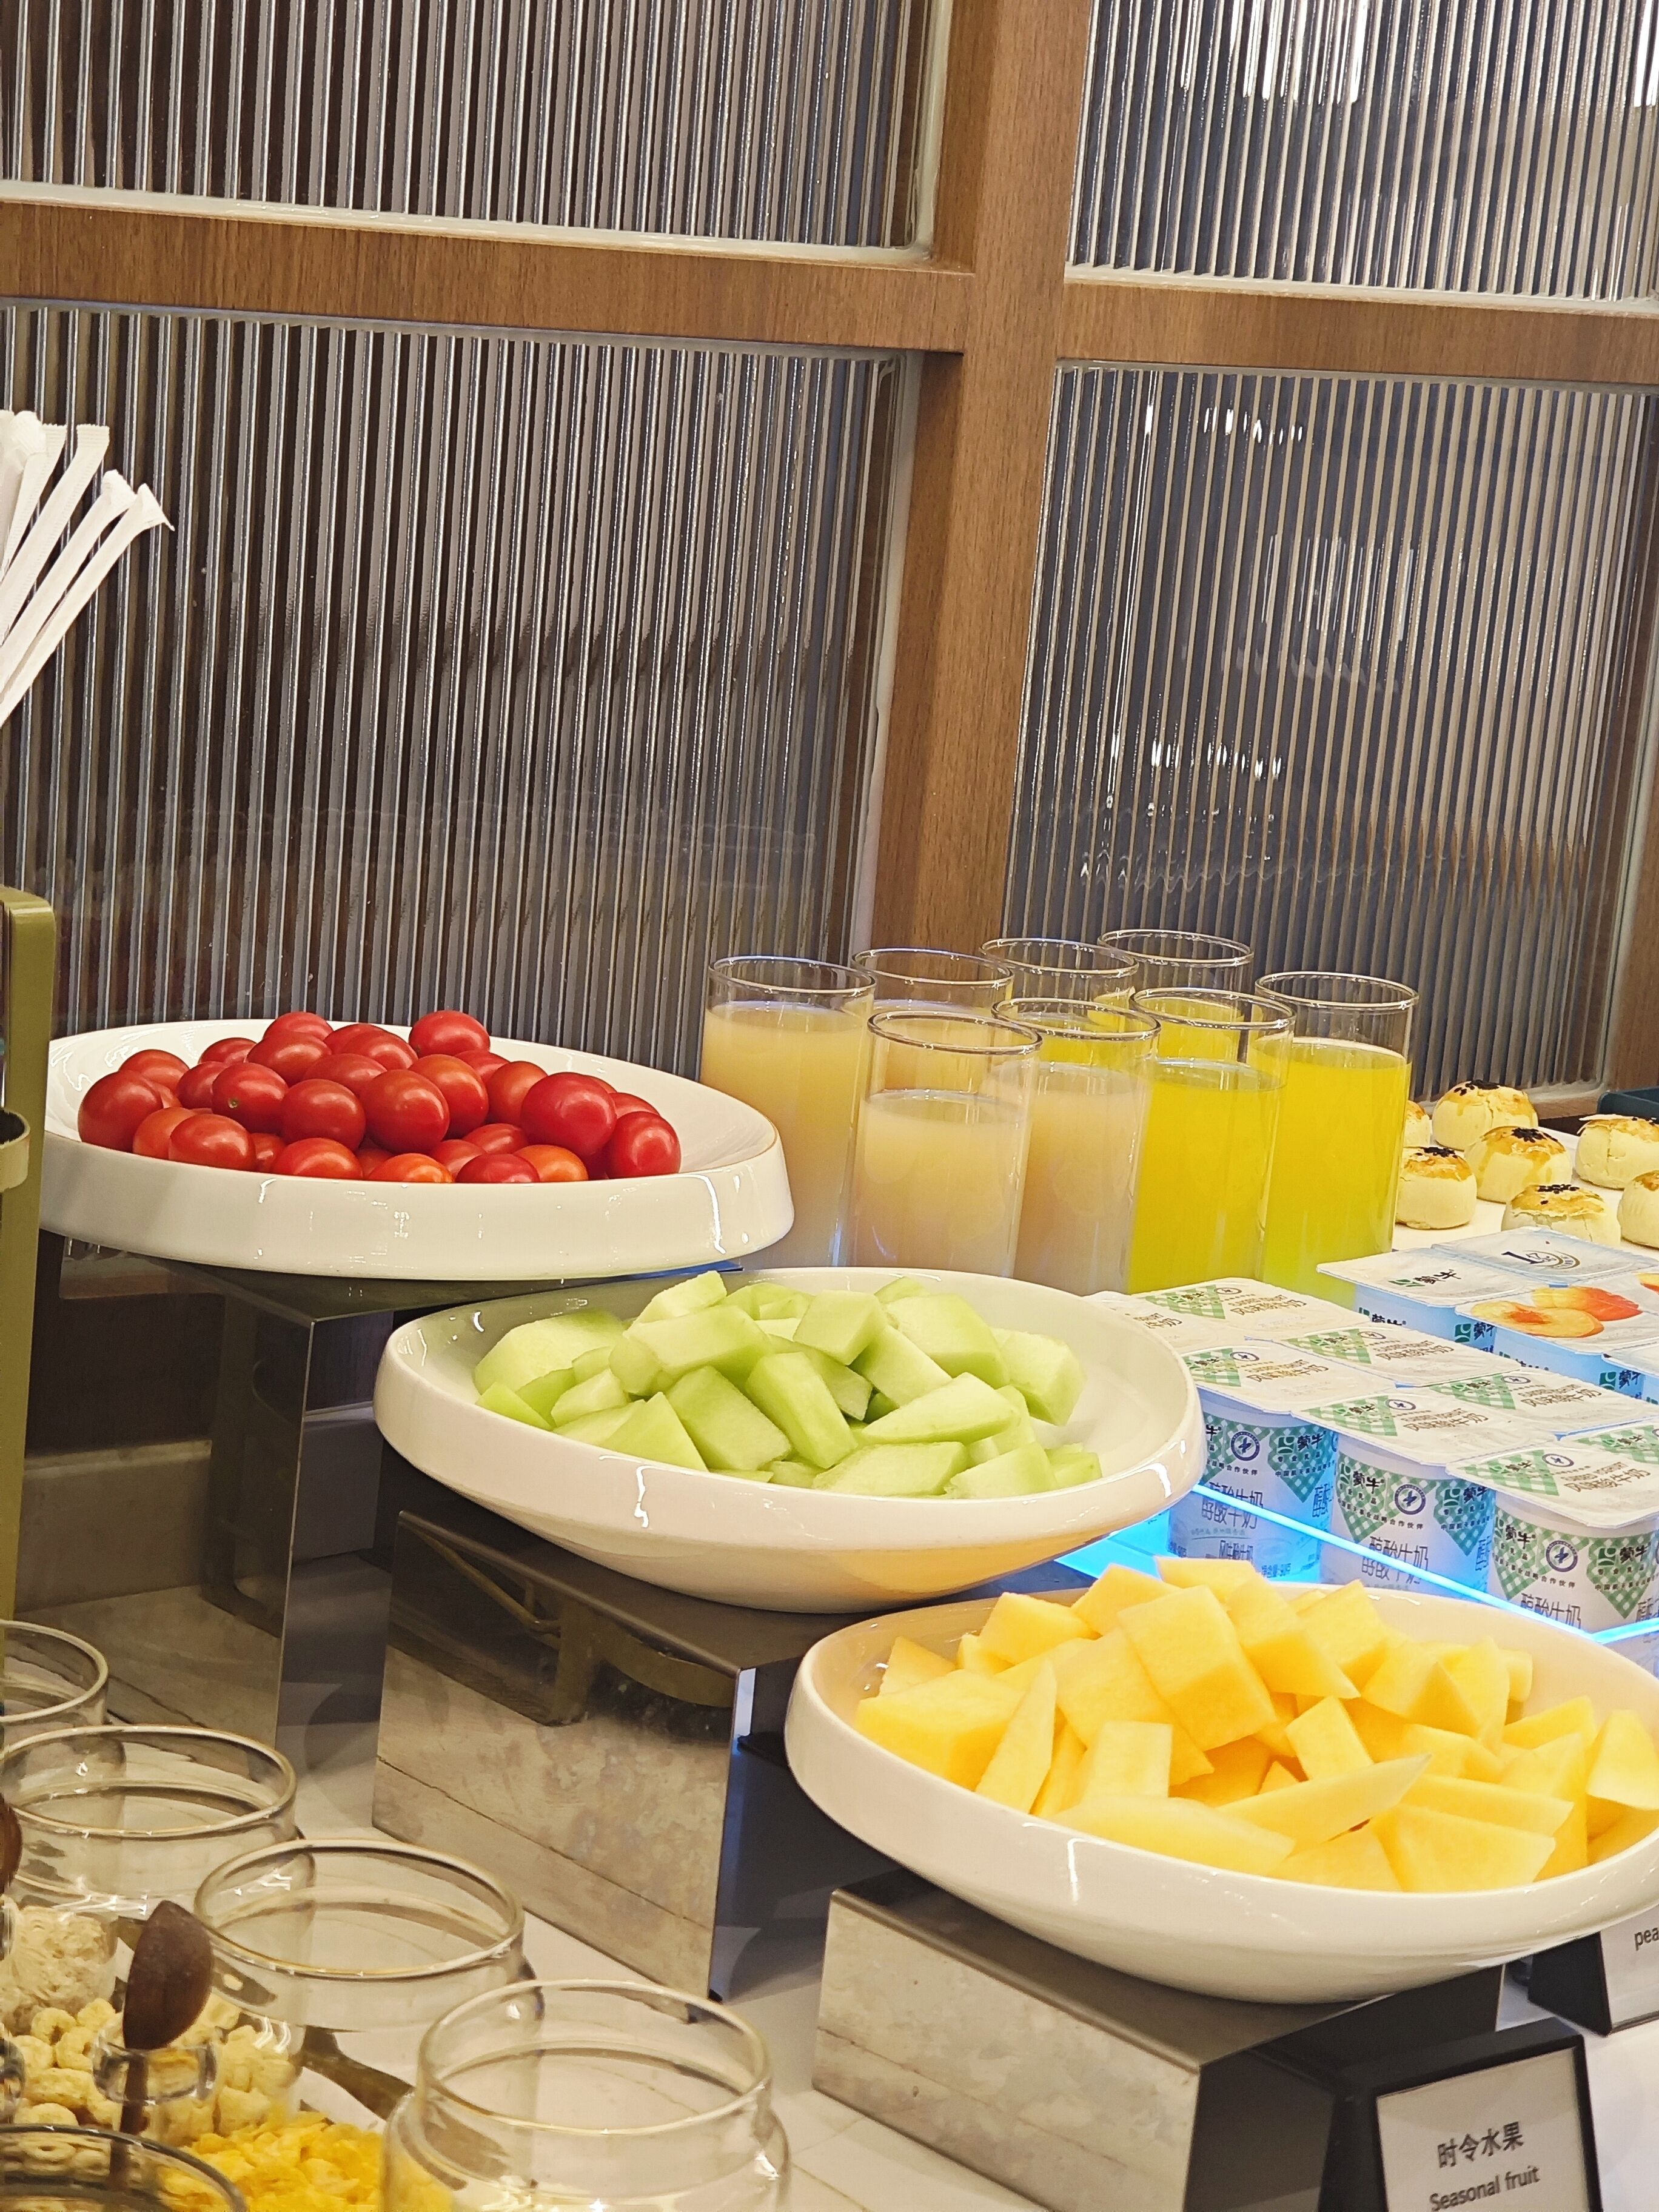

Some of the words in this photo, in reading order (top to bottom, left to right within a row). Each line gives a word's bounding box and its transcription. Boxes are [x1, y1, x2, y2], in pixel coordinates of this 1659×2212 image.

[1634, 1927, 1659, 1951] pea
[1437, 2121, 1524, 2168] 时令水果
[1429, 2173, 1500, 2212] Seasonal
[1504, 2165, 1541, 2191] fruit
